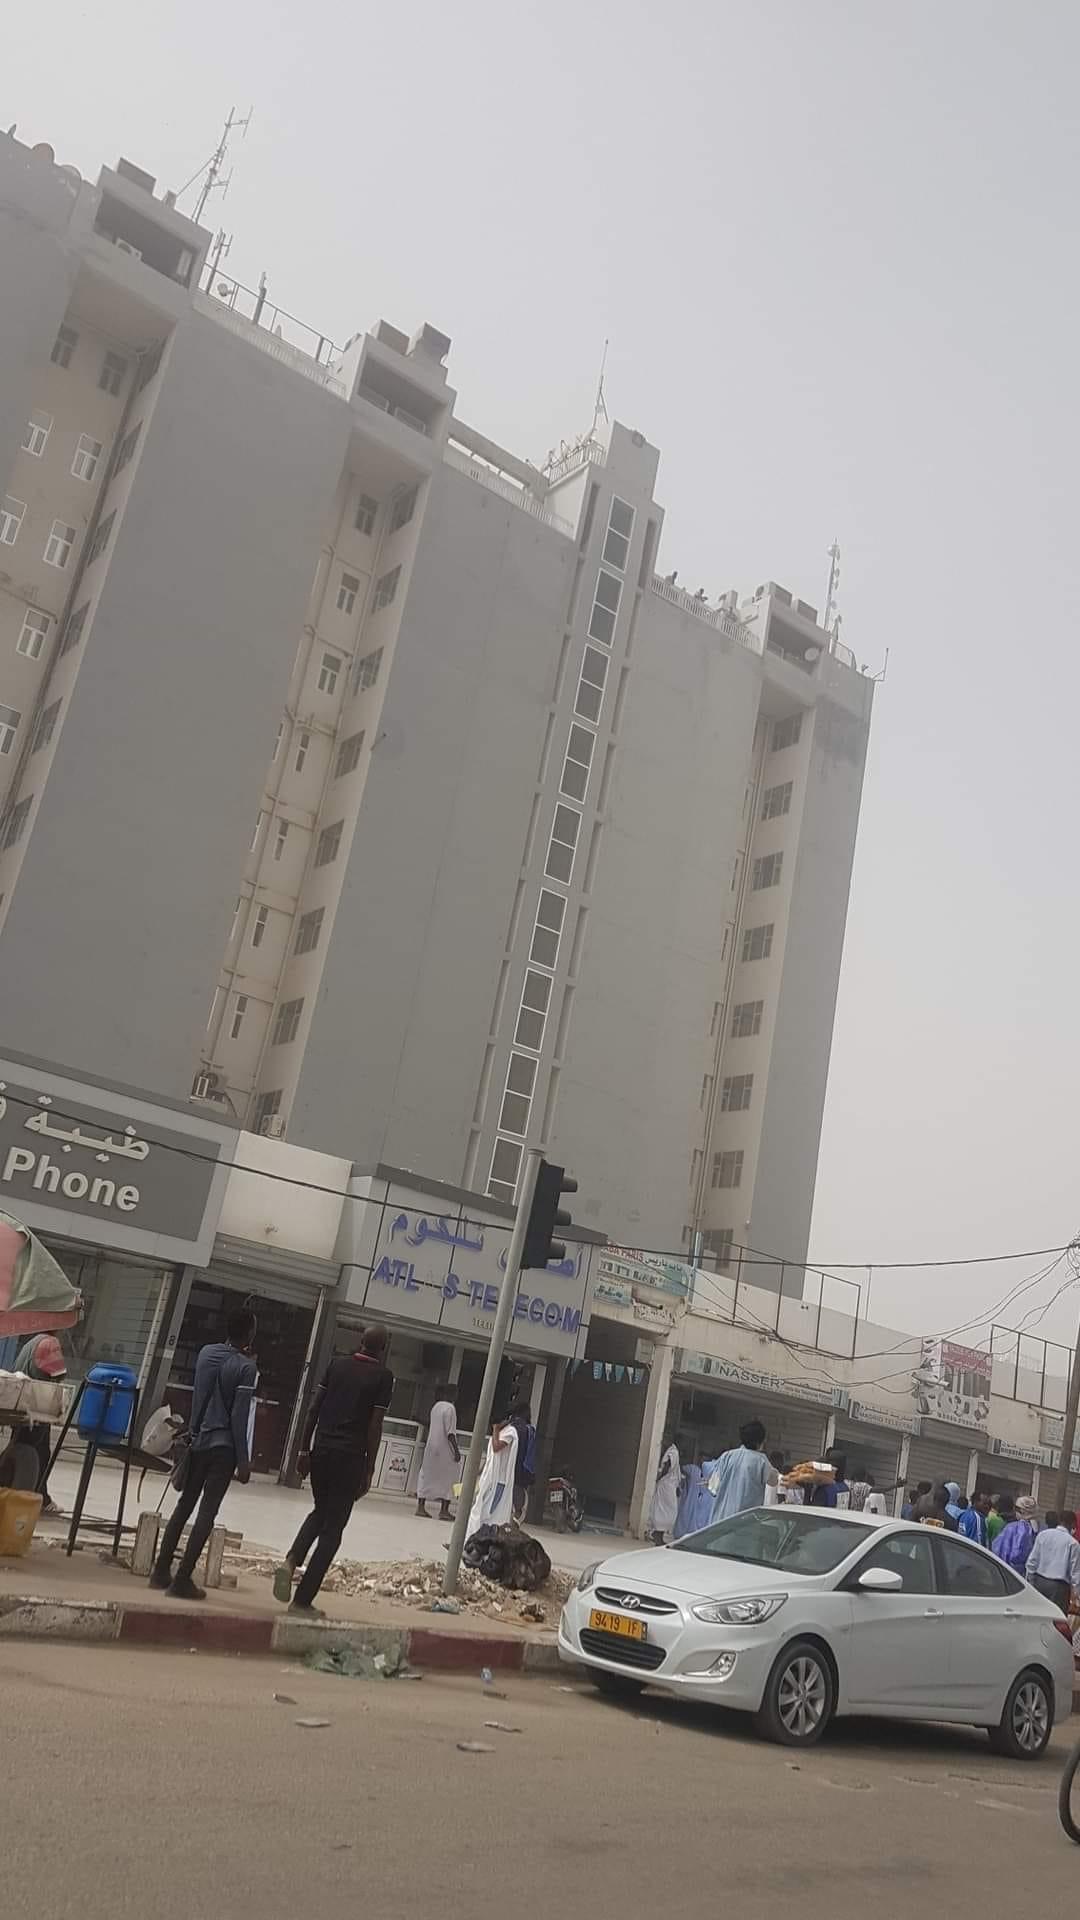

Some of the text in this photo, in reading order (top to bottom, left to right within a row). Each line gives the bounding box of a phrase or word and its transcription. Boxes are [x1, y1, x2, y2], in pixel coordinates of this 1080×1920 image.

[2, 1146, 140, 1212] Phone
[467, 1279, 583, 1335] TEECOM
[719, 1366, 781, 1389] NASSER
